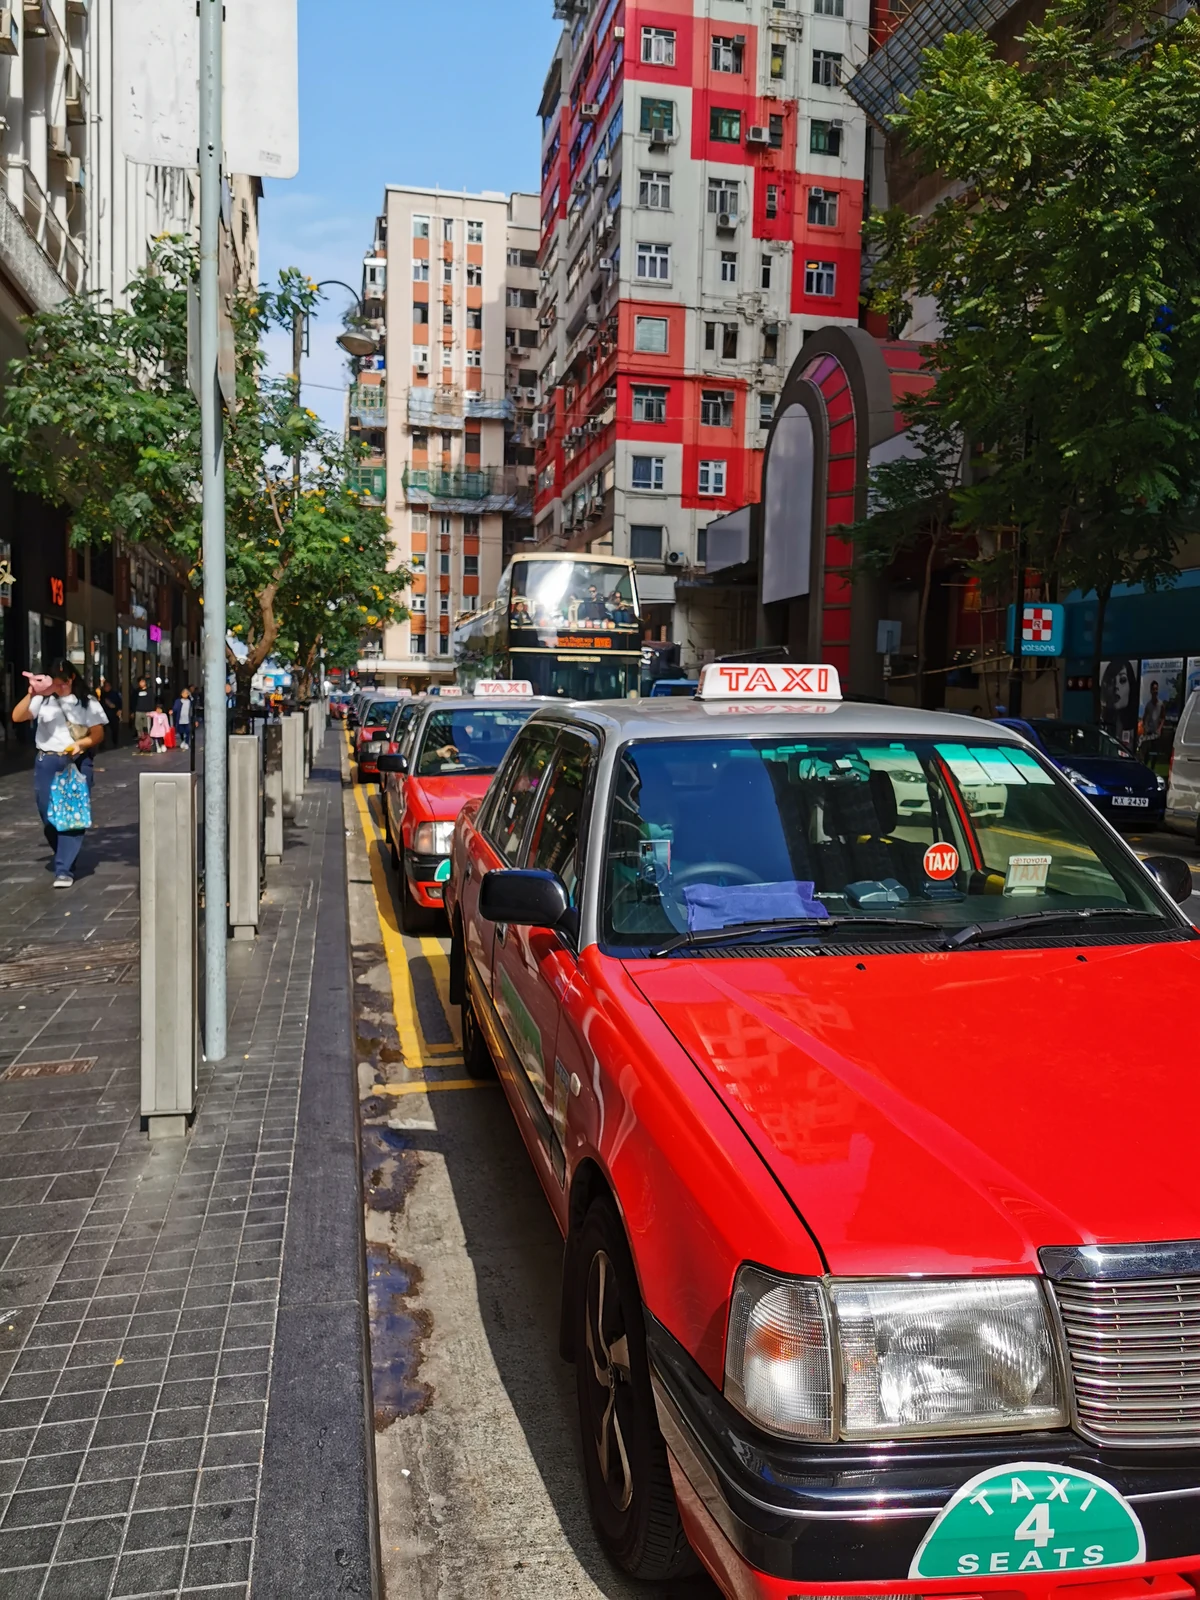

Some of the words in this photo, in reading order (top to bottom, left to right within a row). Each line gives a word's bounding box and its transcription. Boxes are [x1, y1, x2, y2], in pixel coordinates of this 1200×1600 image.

[480, 683, 527, 693] TAXI
[719, 667, 829, 692] TAXI
[1114, 796, 1125, 805] KX
[1128, 797, 1147, 806] 2439
[928, 852, 957, 872] TAXI
[1012, 864, 1047, 881] TAXI
[969, 1476, 1097, 1516] TAXI
[1014, 1502, 1055, 1547] 4
[956, 1544, 1105, 1574] SEATS
